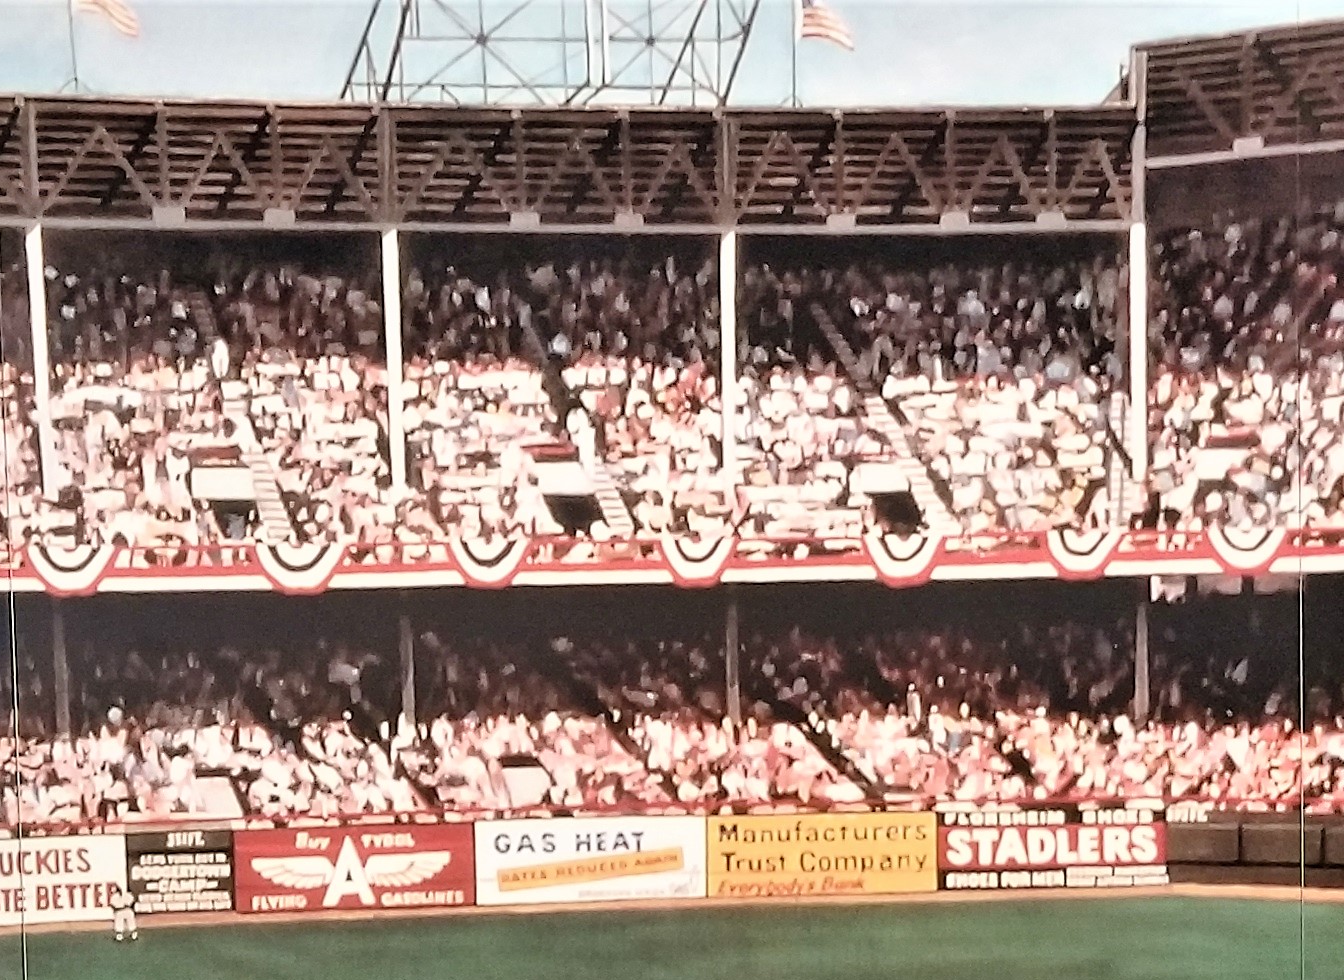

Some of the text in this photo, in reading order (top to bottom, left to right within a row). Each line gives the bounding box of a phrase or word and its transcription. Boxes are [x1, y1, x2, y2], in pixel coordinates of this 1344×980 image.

[718, 820, 927, 843] Manufacturers
[494, 832, 644, 853] GAS HEAT
[946, 825, 1158, 866] STADLERS
[721, 852, 927, 873] Trust Company
[252, 895, 307, 911] FLYING
